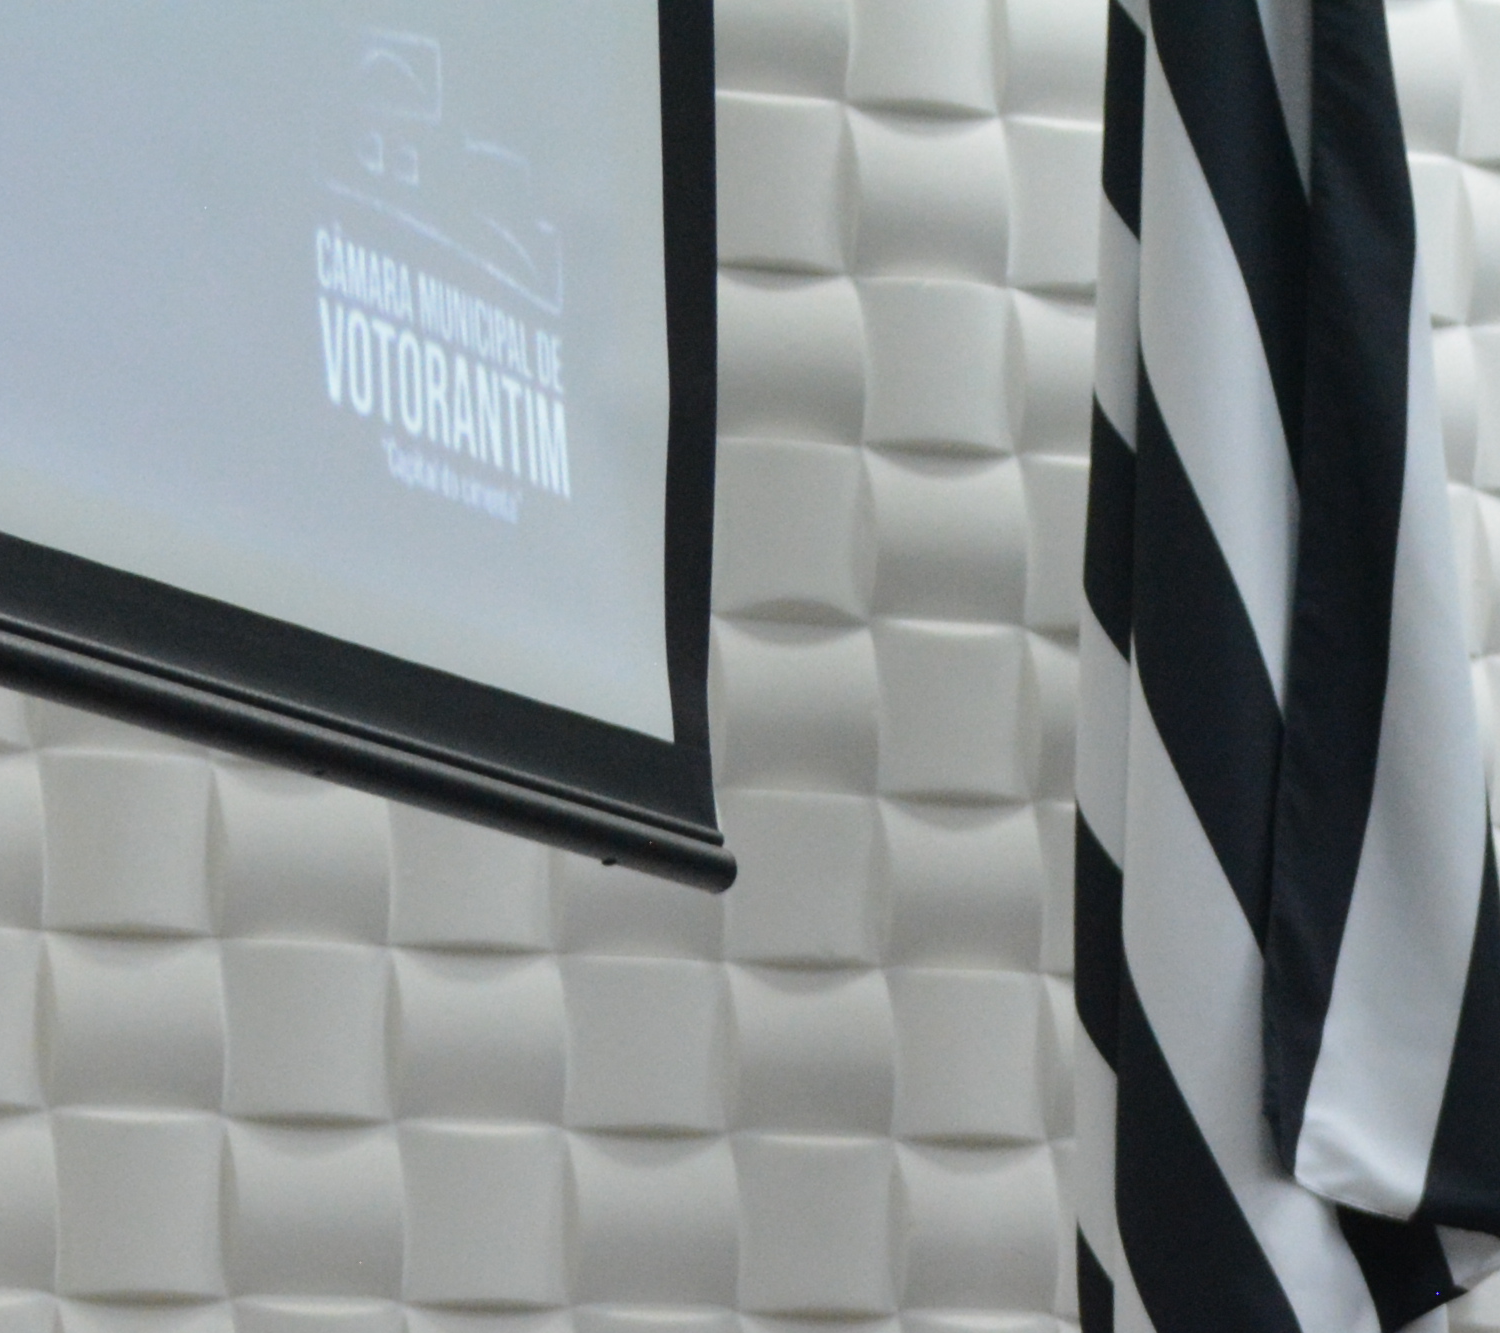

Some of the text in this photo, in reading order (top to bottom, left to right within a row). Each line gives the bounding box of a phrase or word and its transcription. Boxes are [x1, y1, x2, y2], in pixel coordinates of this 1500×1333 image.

[315, 222, 565, 394] CÂMARA MUNICIPAL DE
[319, 297, 571, 500] VOTORANTIM
